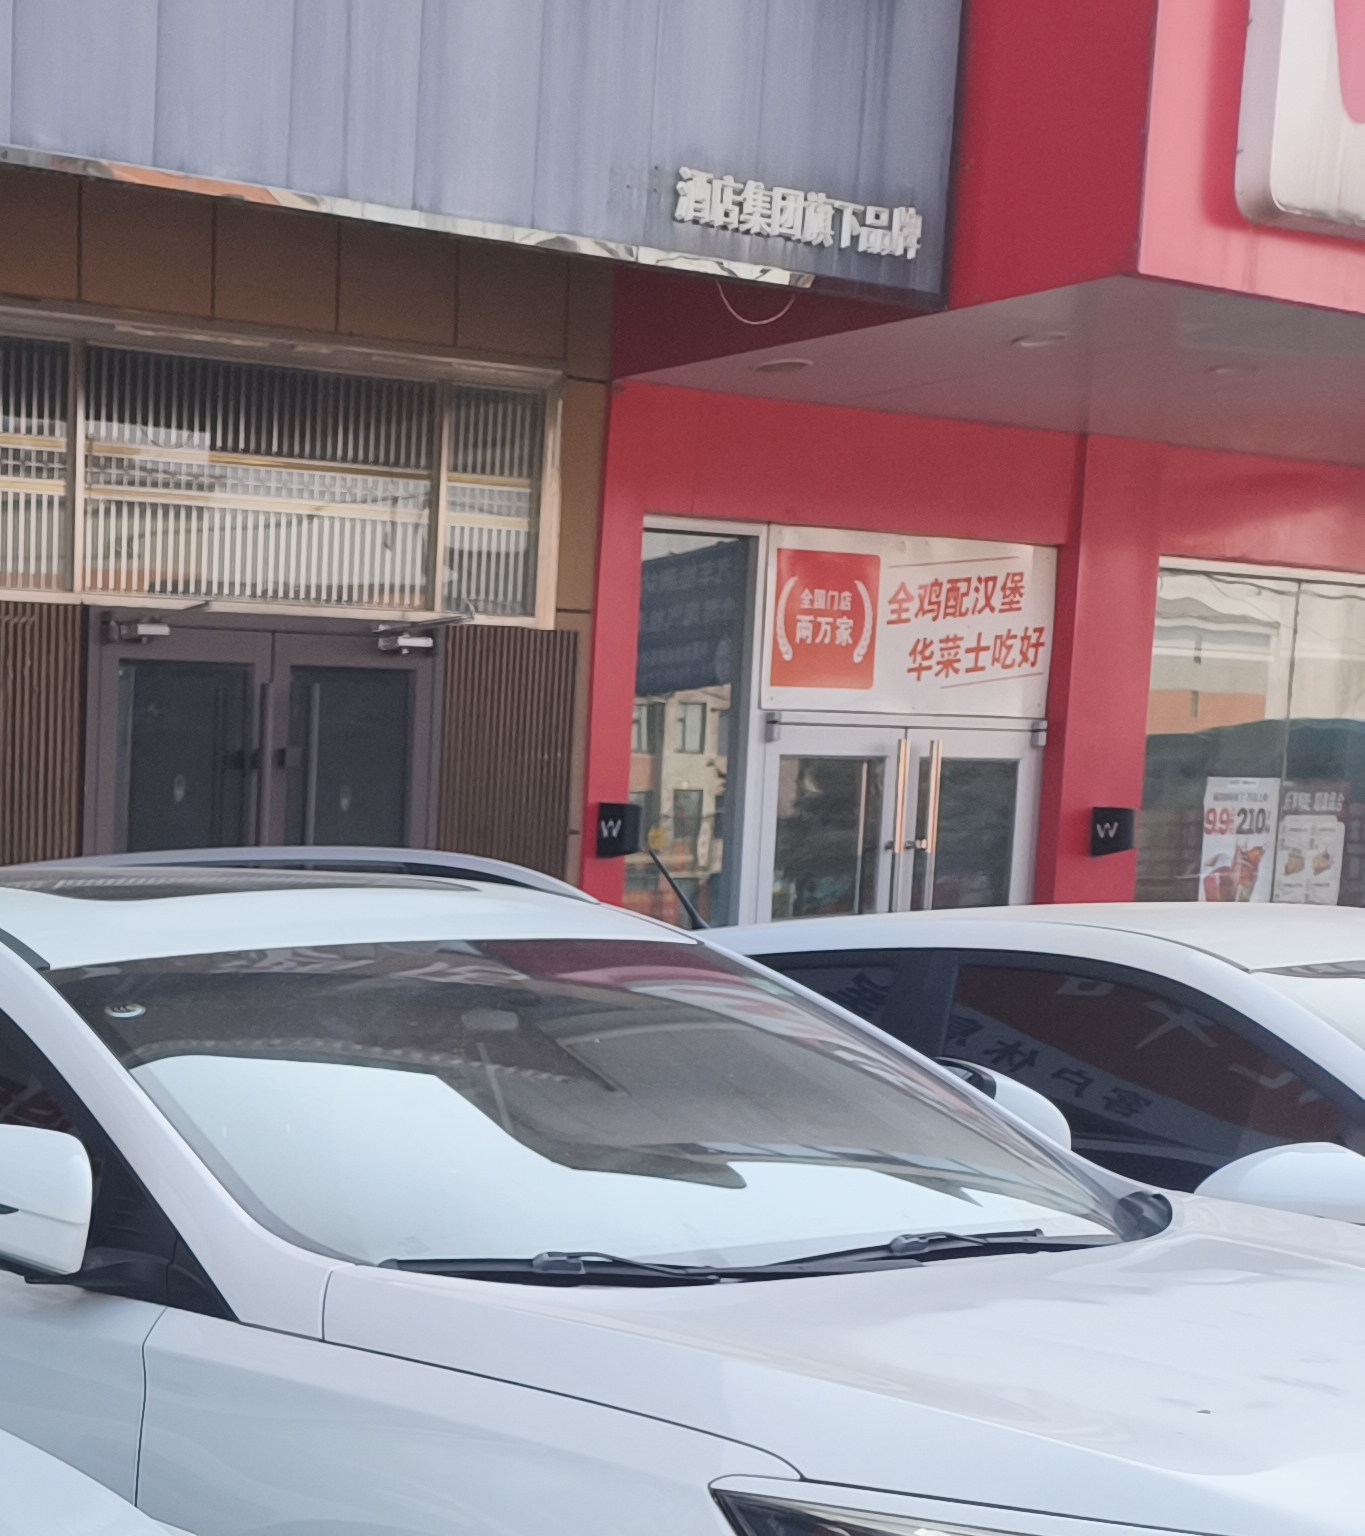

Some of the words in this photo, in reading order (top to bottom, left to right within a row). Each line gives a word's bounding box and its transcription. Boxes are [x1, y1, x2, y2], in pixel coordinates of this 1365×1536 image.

[674, 166, 922, 259] 酒店集团旗下品牌
[799, 588, 853, 611] 全国门店
[886, 571, 1026, 626] 全鸡配汉堡
[795, 614, 854, 647] 两万家
